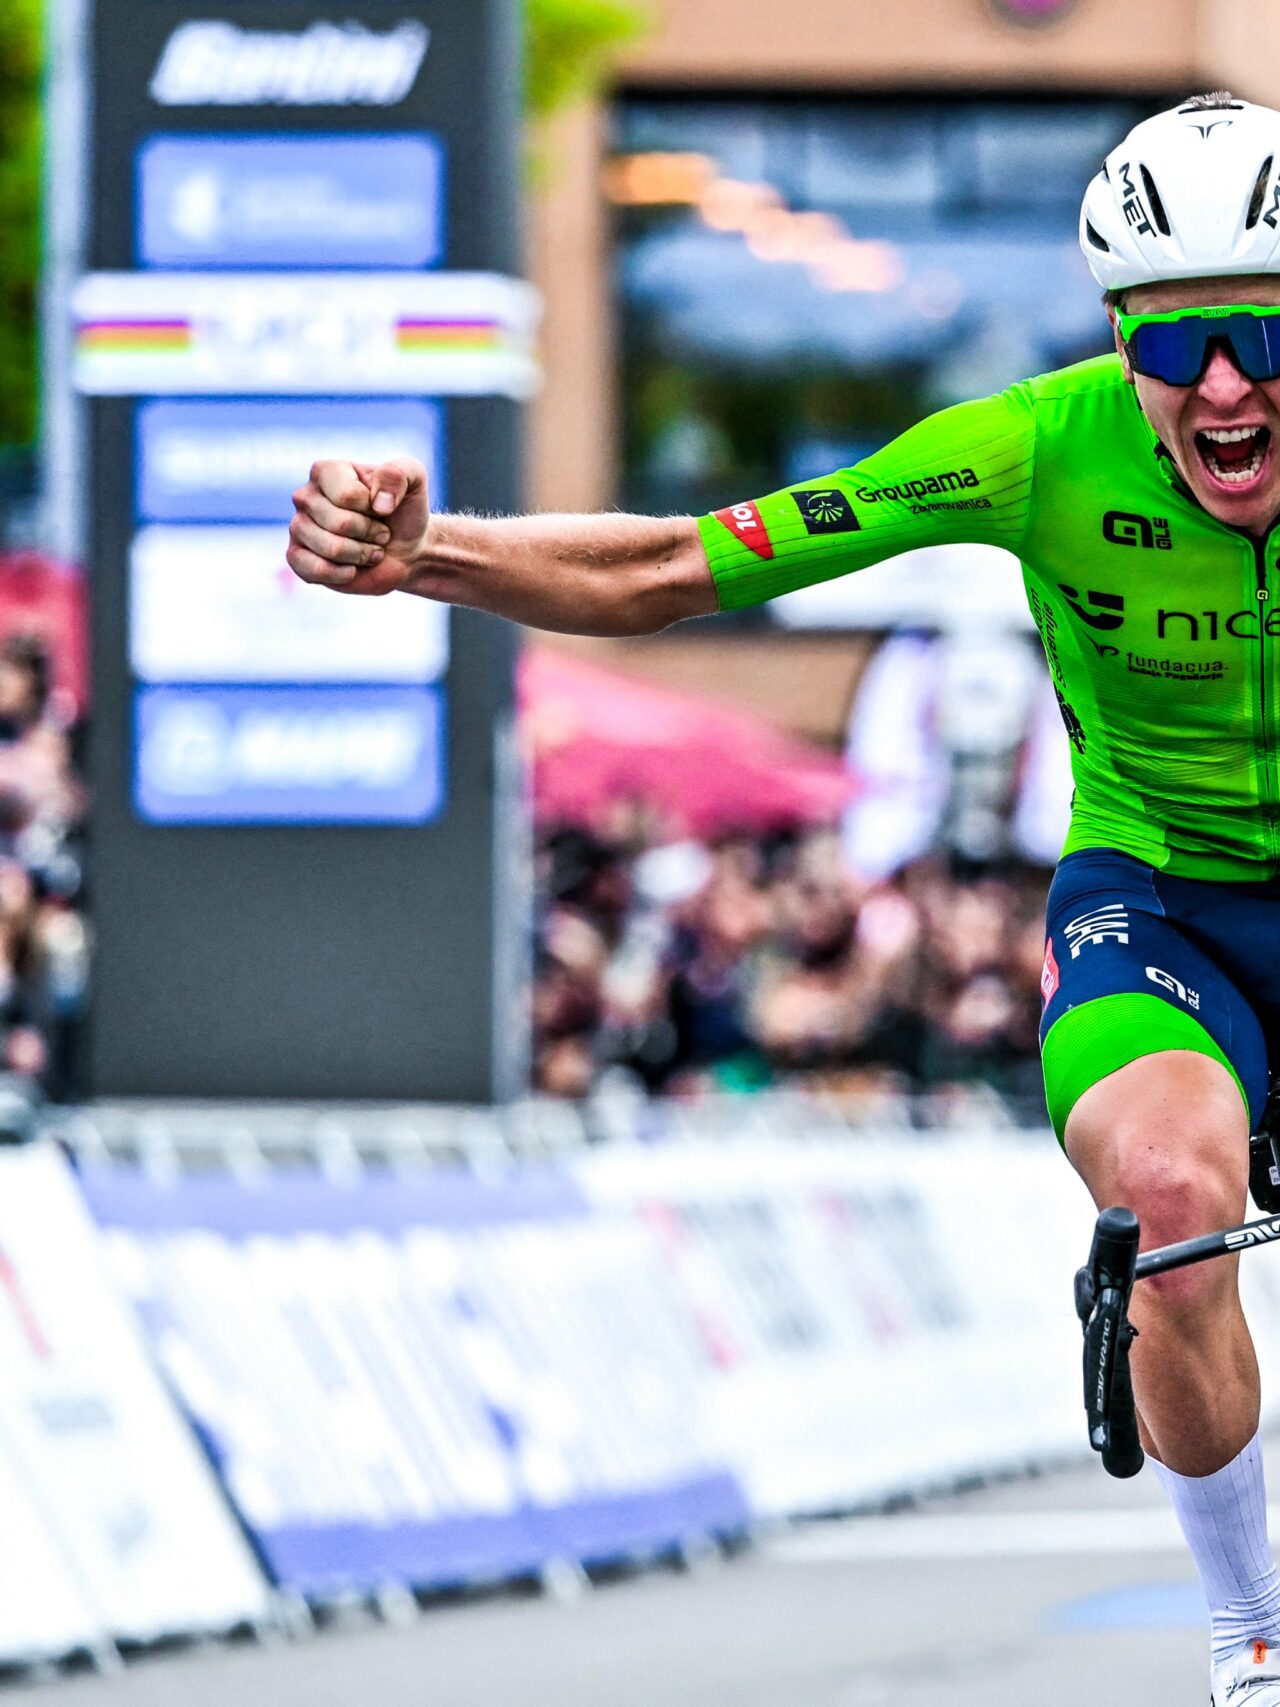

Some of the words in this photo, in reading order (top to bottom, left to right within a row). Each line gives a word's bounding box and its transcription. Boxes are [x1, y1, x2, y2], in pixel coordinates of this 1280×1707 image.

[1118, 162, 1157, 238] MET
[855, 468, 980, 503] Groupama
[1126, 652, 1223, 673] fundacija
[1064, 904, 1129, 960] UAE
[1096, 1318, 1111, 1412] DURA-ACE
